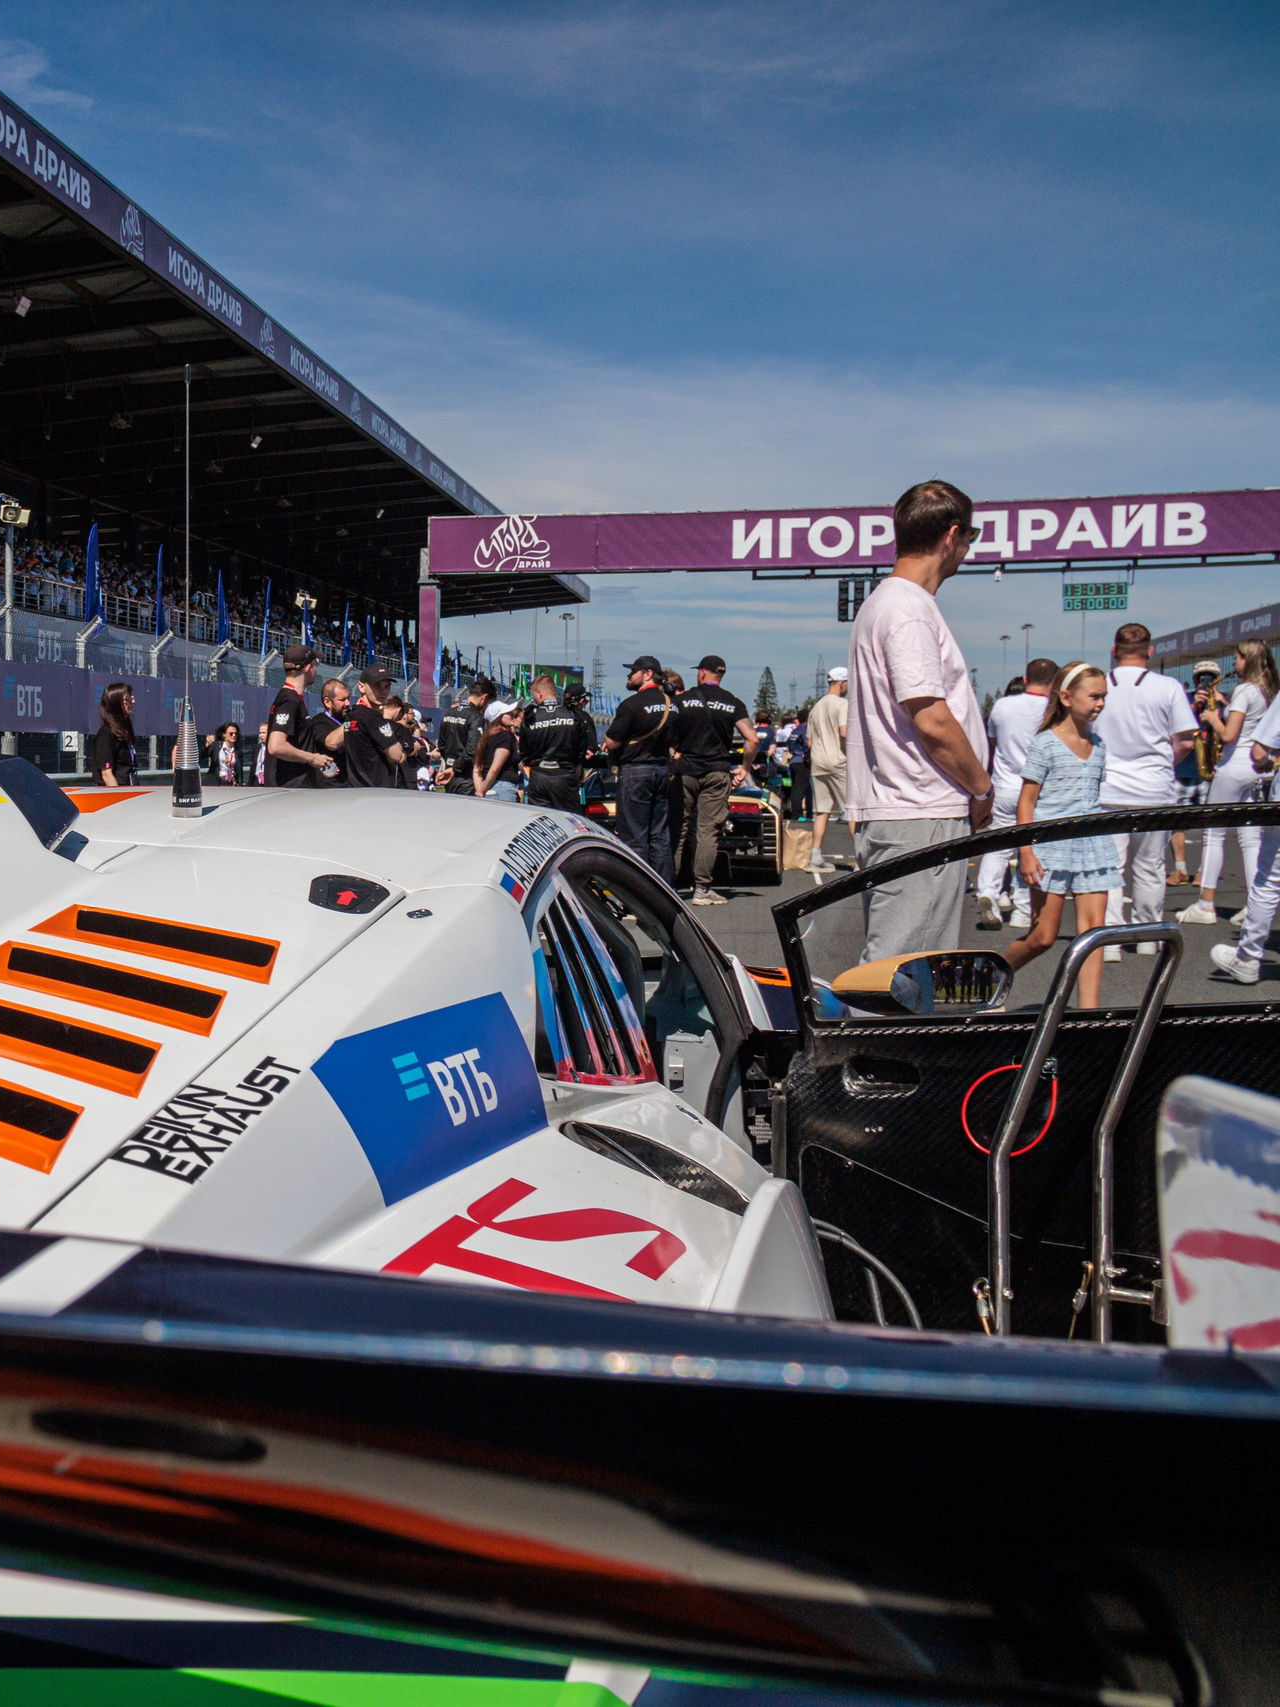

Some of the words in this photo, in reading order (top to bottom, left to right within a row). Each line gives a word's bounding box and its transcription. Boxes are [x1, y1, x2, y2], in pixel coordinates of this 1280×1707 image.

[34, 139, 92, 209] ДРАЙВ
[168, 246, 206, 299] ИГОРА
[207, 278, 243, 327] ДРАЙВ
[290, 345, 314, 387] ИГОРА
[315, 366, 339, 402] ДРАЙВ
[732, 515, 896, 560] ИГОР
[966, 501, 1207, 560] ДРАЙВ
[518, 560, 551, 569] ДРАЙВ
[1064, 597, 1127, 611] 06:00:00
[1066, 582, 1127, 596] 13:07:37
[38, 629, 61, 660] ВТБ
[16, 684, 43, 718] ВТБ
[231, 700, 245, 724] ВТБ
[65, 735, 74, 748] 2
[426, 1047, 499, 1127] ВТБ
[163, 1055, 302, 1186] EXHAUST
